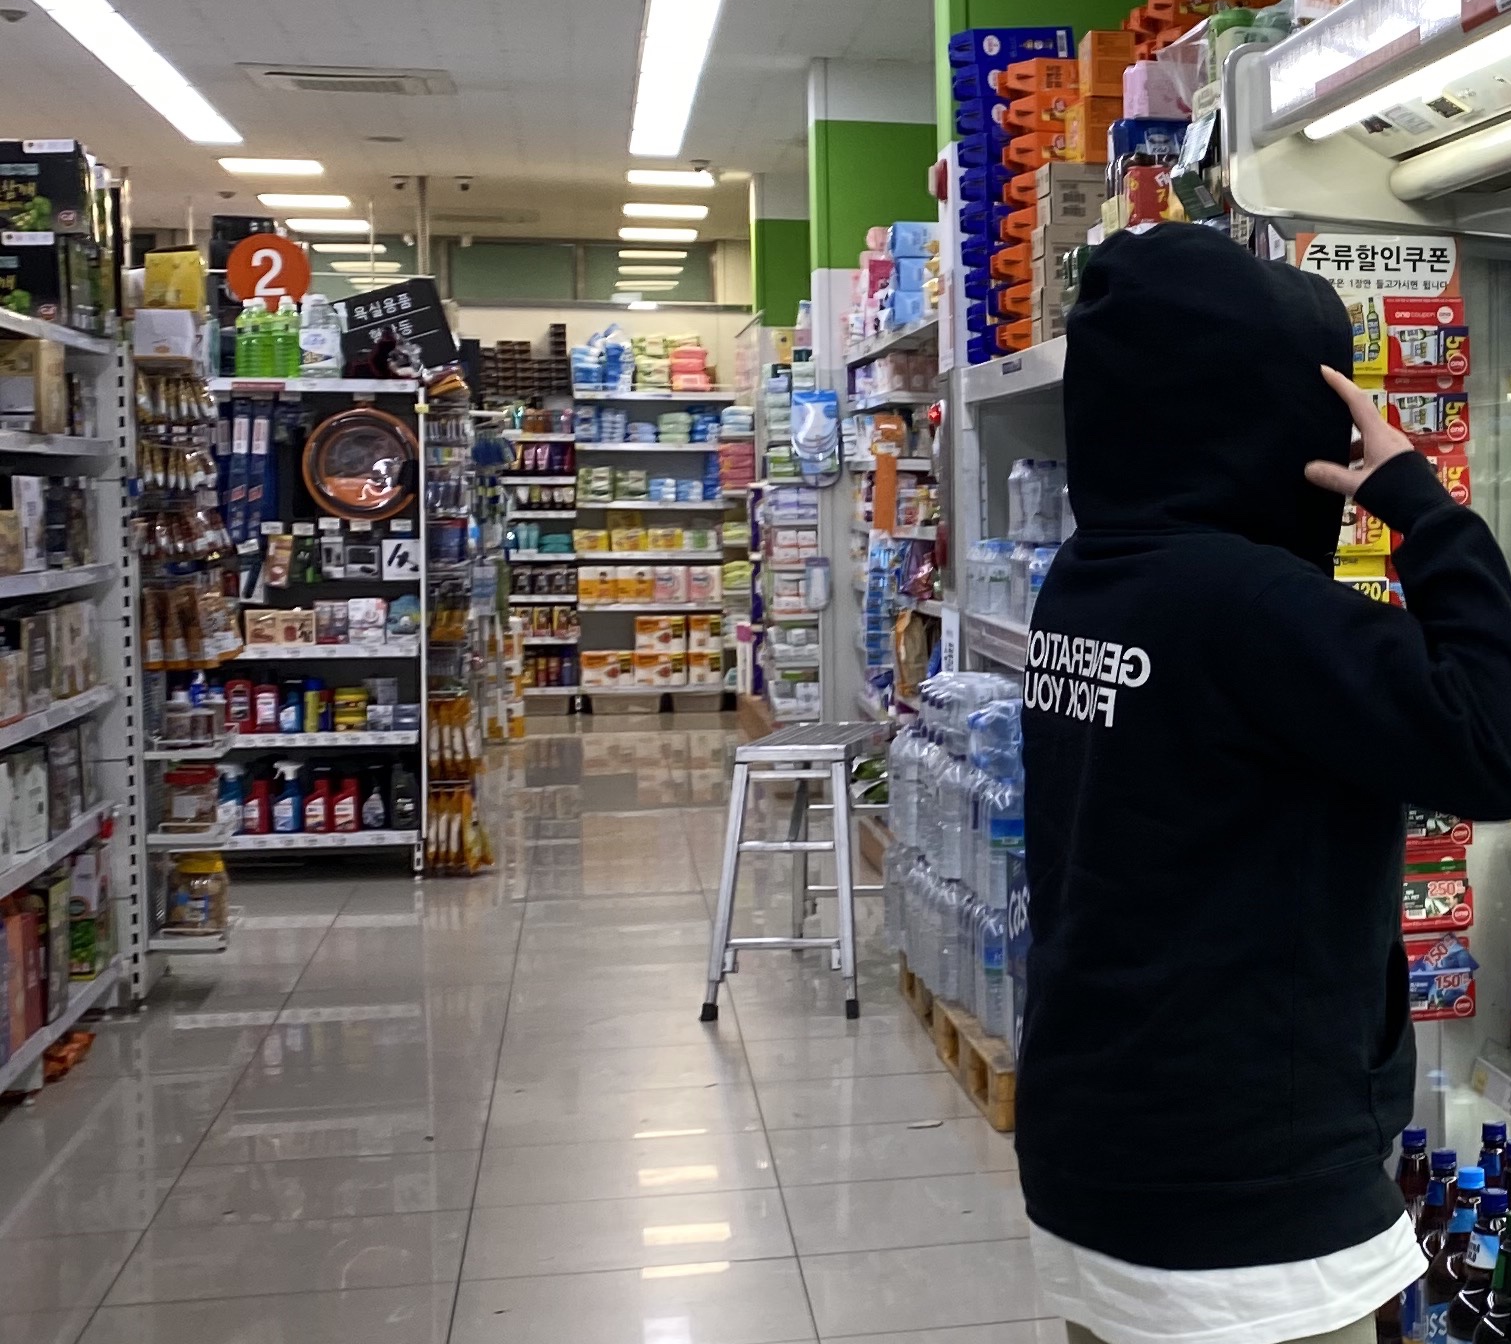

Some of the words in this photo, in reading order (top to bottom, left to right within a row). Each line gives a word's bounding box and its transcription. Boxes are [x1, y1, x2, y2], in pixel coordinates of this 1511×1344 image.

[1306, 243, 1451, 273] 주류할인쿠폰
[251, 248, 286, 296] 2
[1428, 880, 1456, 895] 250
[1435, 974, 1460, 990] 150
